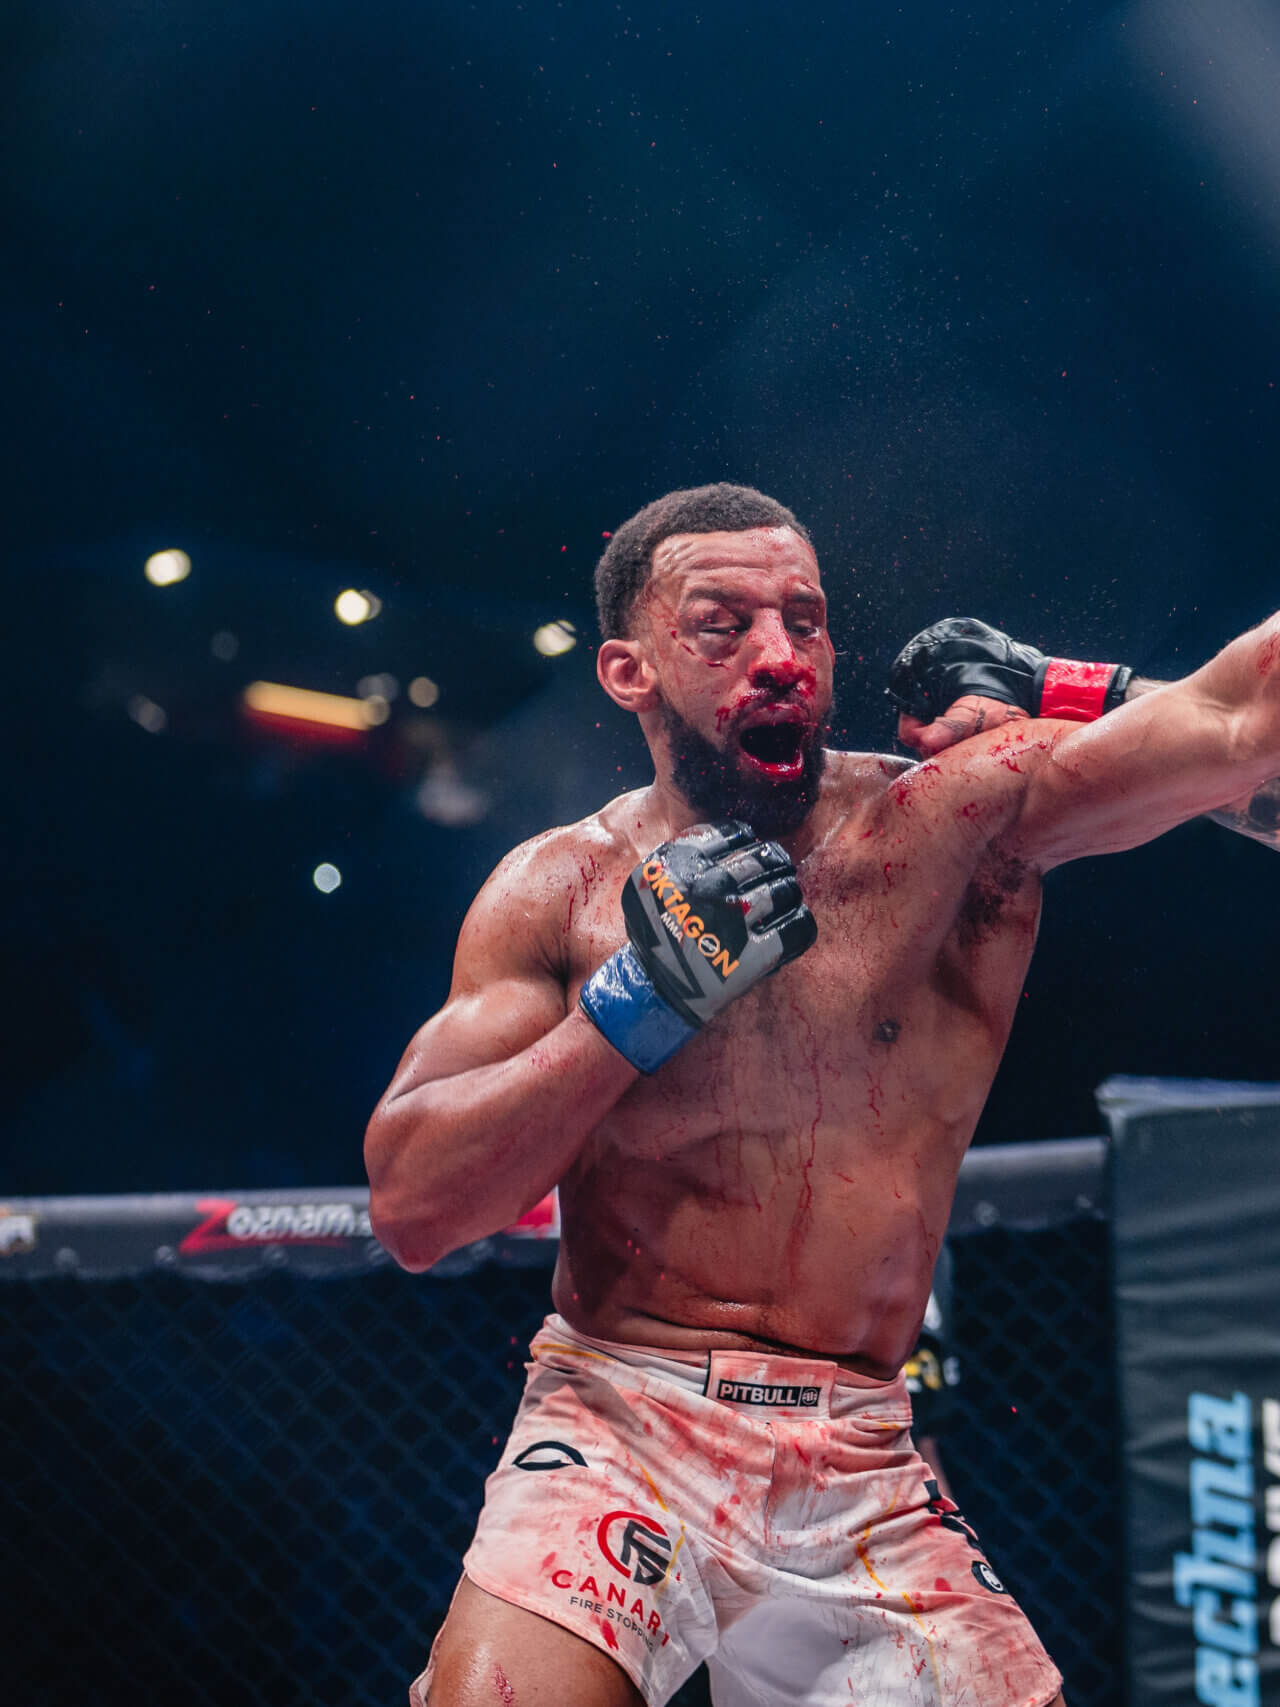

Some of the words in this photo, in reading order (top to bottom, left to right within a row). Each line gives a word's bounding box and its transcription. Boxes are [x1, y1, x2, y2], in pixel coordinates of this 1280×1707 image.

[642, 860, 740, 978] OKTAGON
[660, 911, 685, 944] MMA
[719, 1383, 797, 1405] PITBULL
[569, 1596, 603, 1615] FIRE
